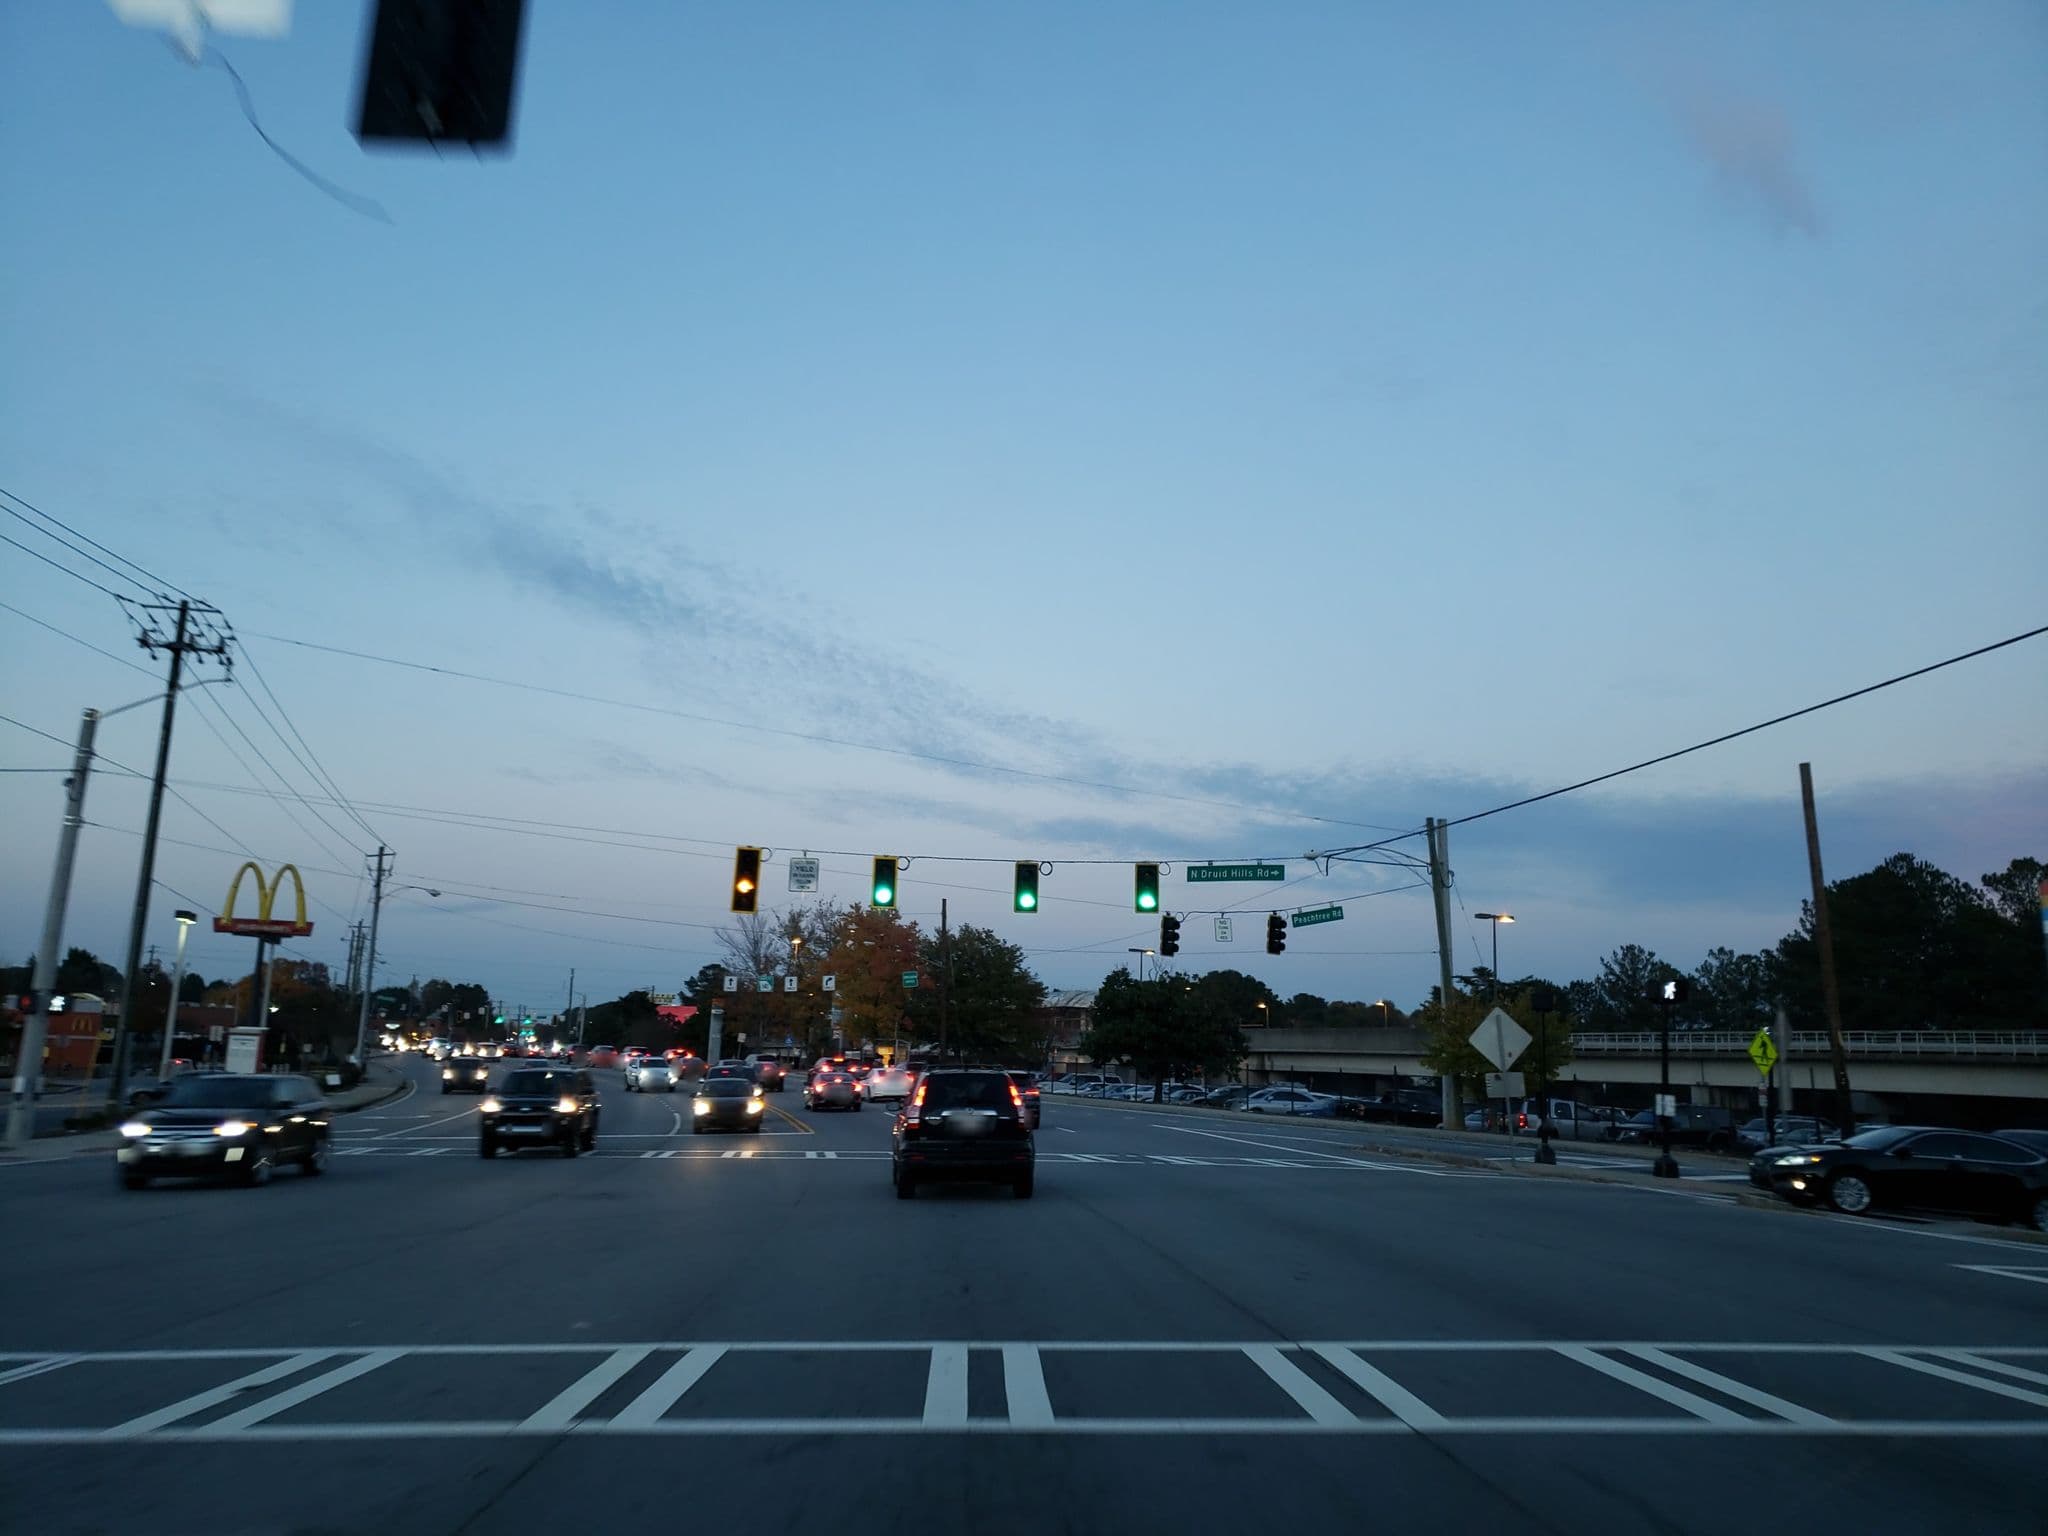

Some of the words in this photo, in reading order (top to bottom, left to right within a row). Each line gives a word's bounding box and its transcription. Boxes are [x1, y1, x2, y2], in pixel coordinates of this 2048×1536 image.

[1191, 869, 1198, 879] N
[1201, 869, 1228, 879] Druid
[1231, 868, 1253, 878] Hills
[1257, 868, 1269, 878] Rd
[1294, 912, 1331, 924] Peachtree
[1332, 909, 1342, 919] Rd
